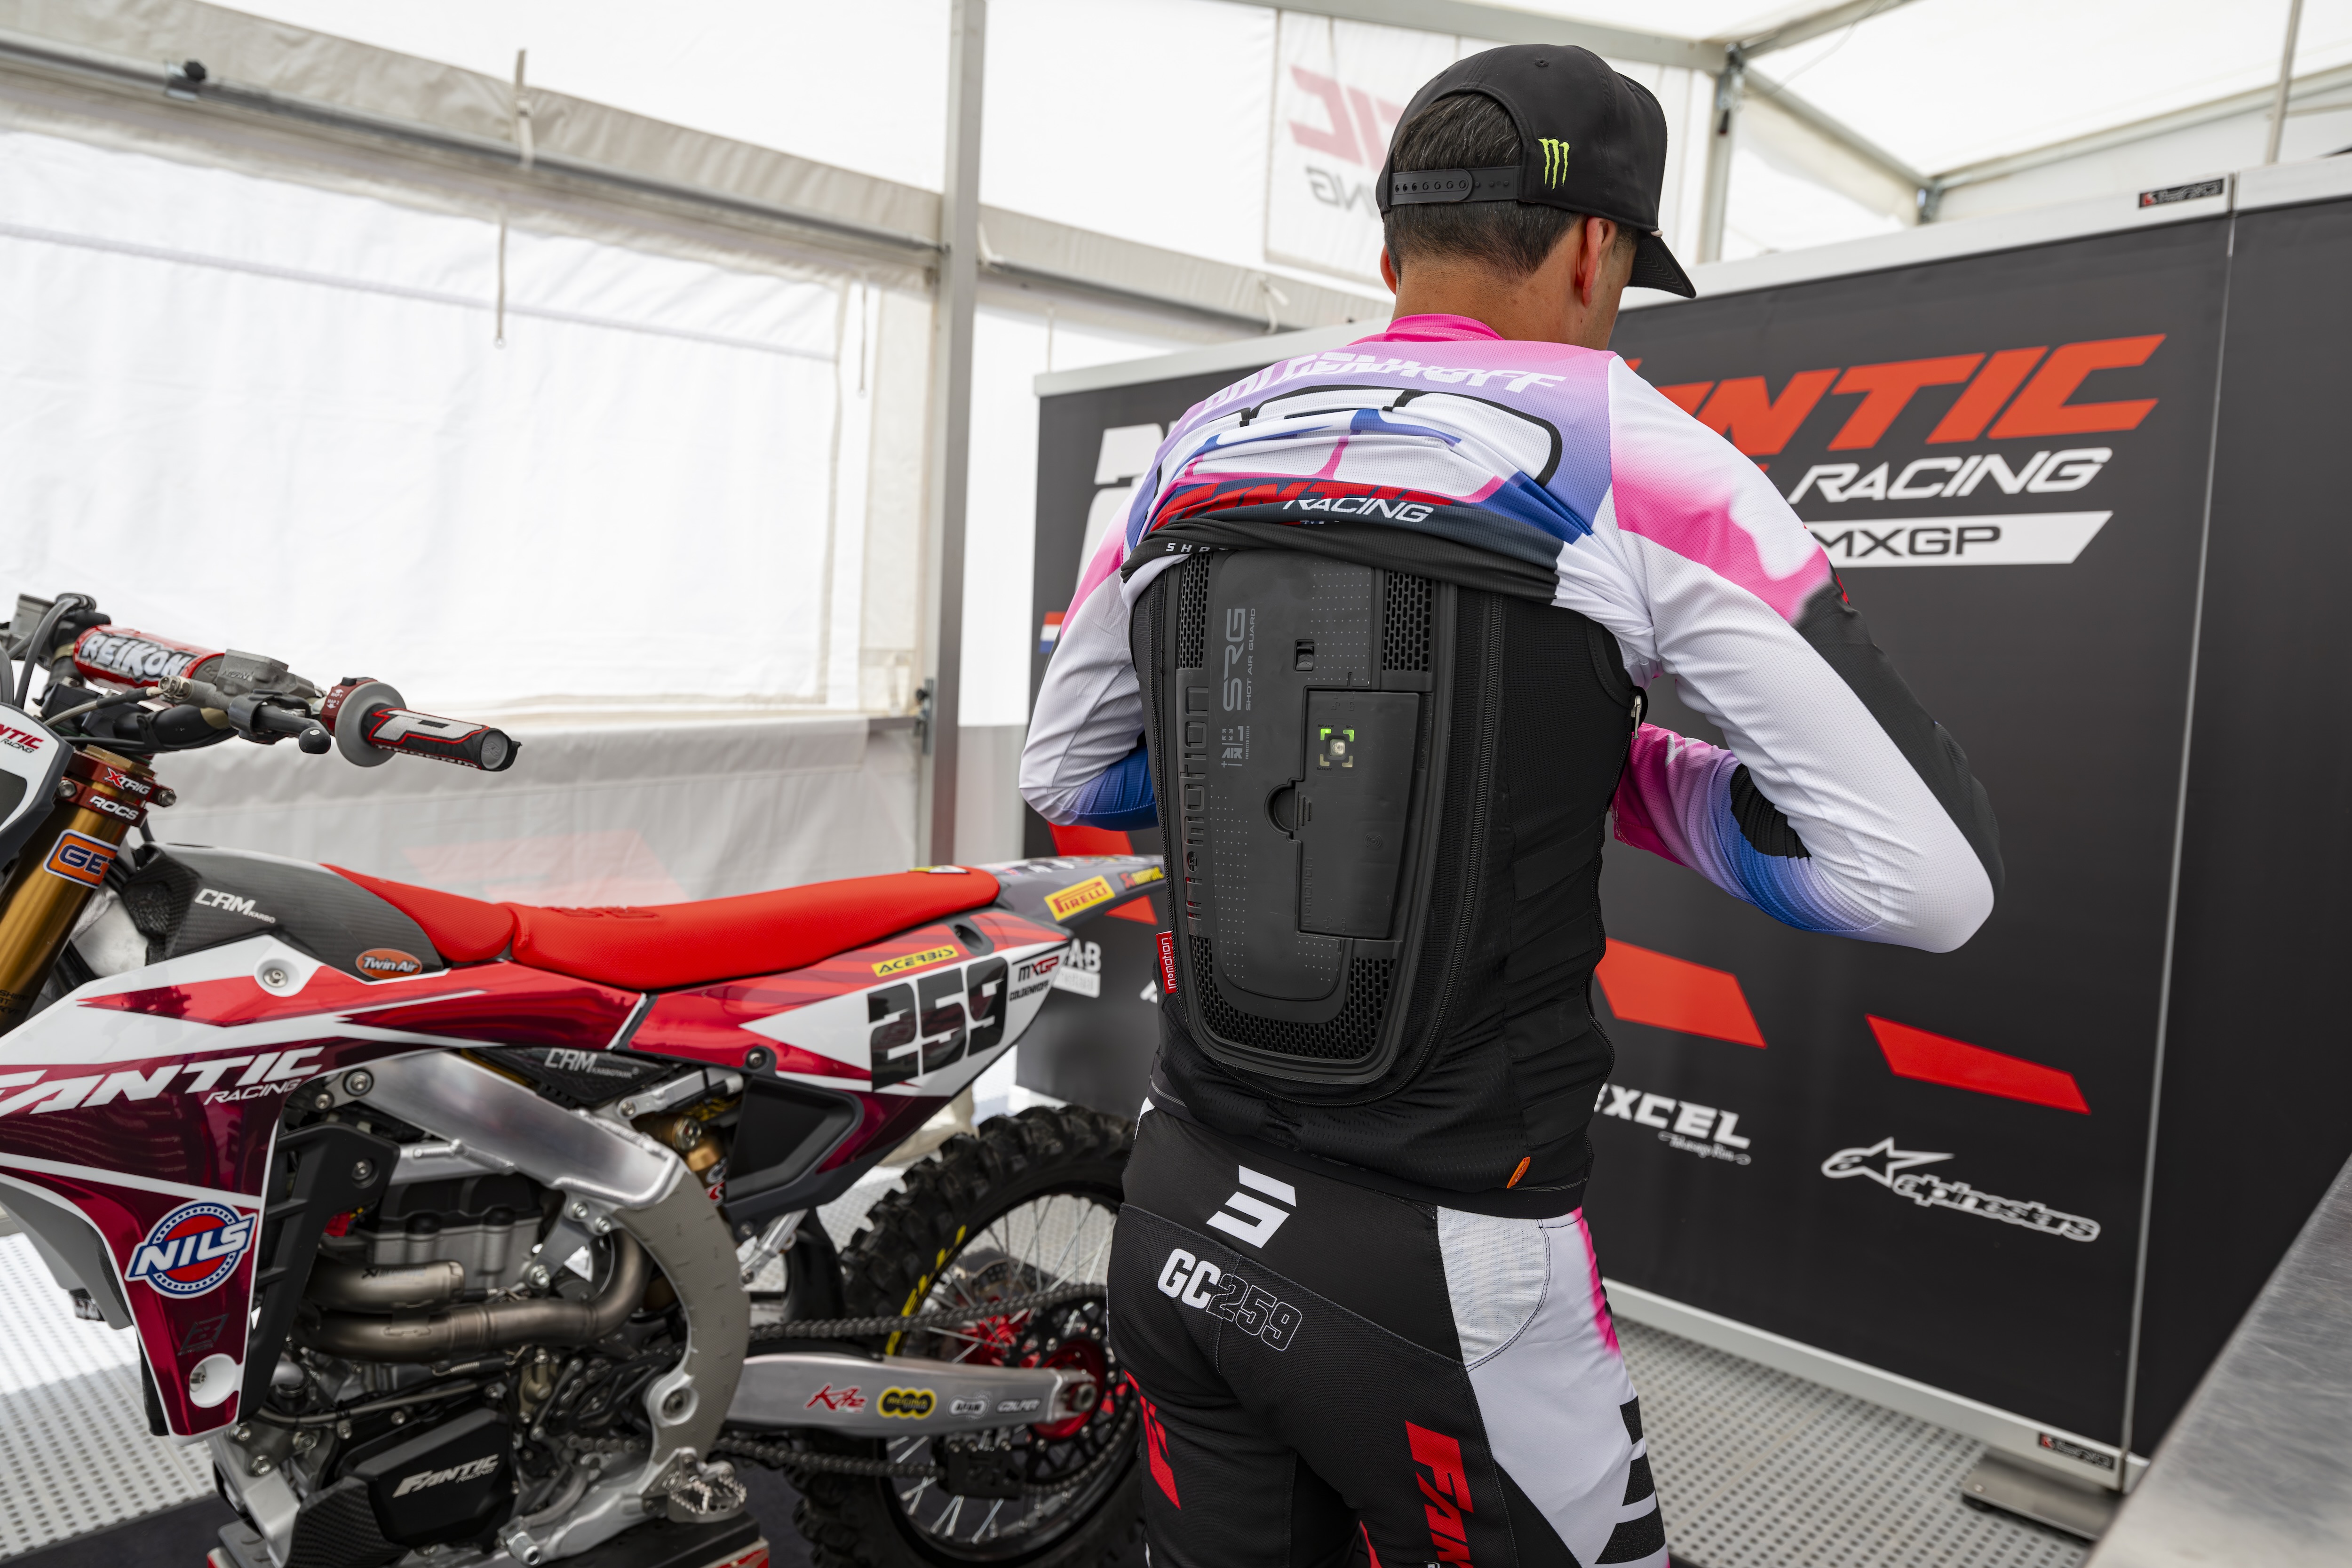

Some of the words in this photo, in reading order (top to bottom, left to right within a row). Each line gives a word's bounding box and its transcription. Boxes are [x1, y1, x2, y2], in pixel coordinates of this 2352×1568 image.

[1625, 334, 2167, 455] NTIC
[1787, 447, 2113, 504] RACING
[1283, 498, 1434, 523] RACING
[1811, 525, 2002, 558] MXGP
[82, 634, 192, 678] REIKON
[1223, 608, 1246, 711] SRG
[0, 738, 35, 753] RACING
[103, 767, 151, 796] XTRIG
[88, 796, 139, 820] ROCS
[58, 844, 114, 876] GE
[194, 888, 256, 915] CRM
[248, 910, 276, 929] KARBO
[1052, 881, 1108, 914] PIRELLI
[363, 956, 396, 971] Twin
[396, 960, 419, 973] Air
[1018, 955, 1059, 982] MXGP
[867, 956, 1008, 1092] 259
[544, 1047, 598, 1074] CRM
[203, 1078, 303, 1106] RACING
[134, 1219, 251, 1276] NILS
[1157, 1248, 1303, 1351] GC259
[392, 1453, 500, 1498] FANTIC
